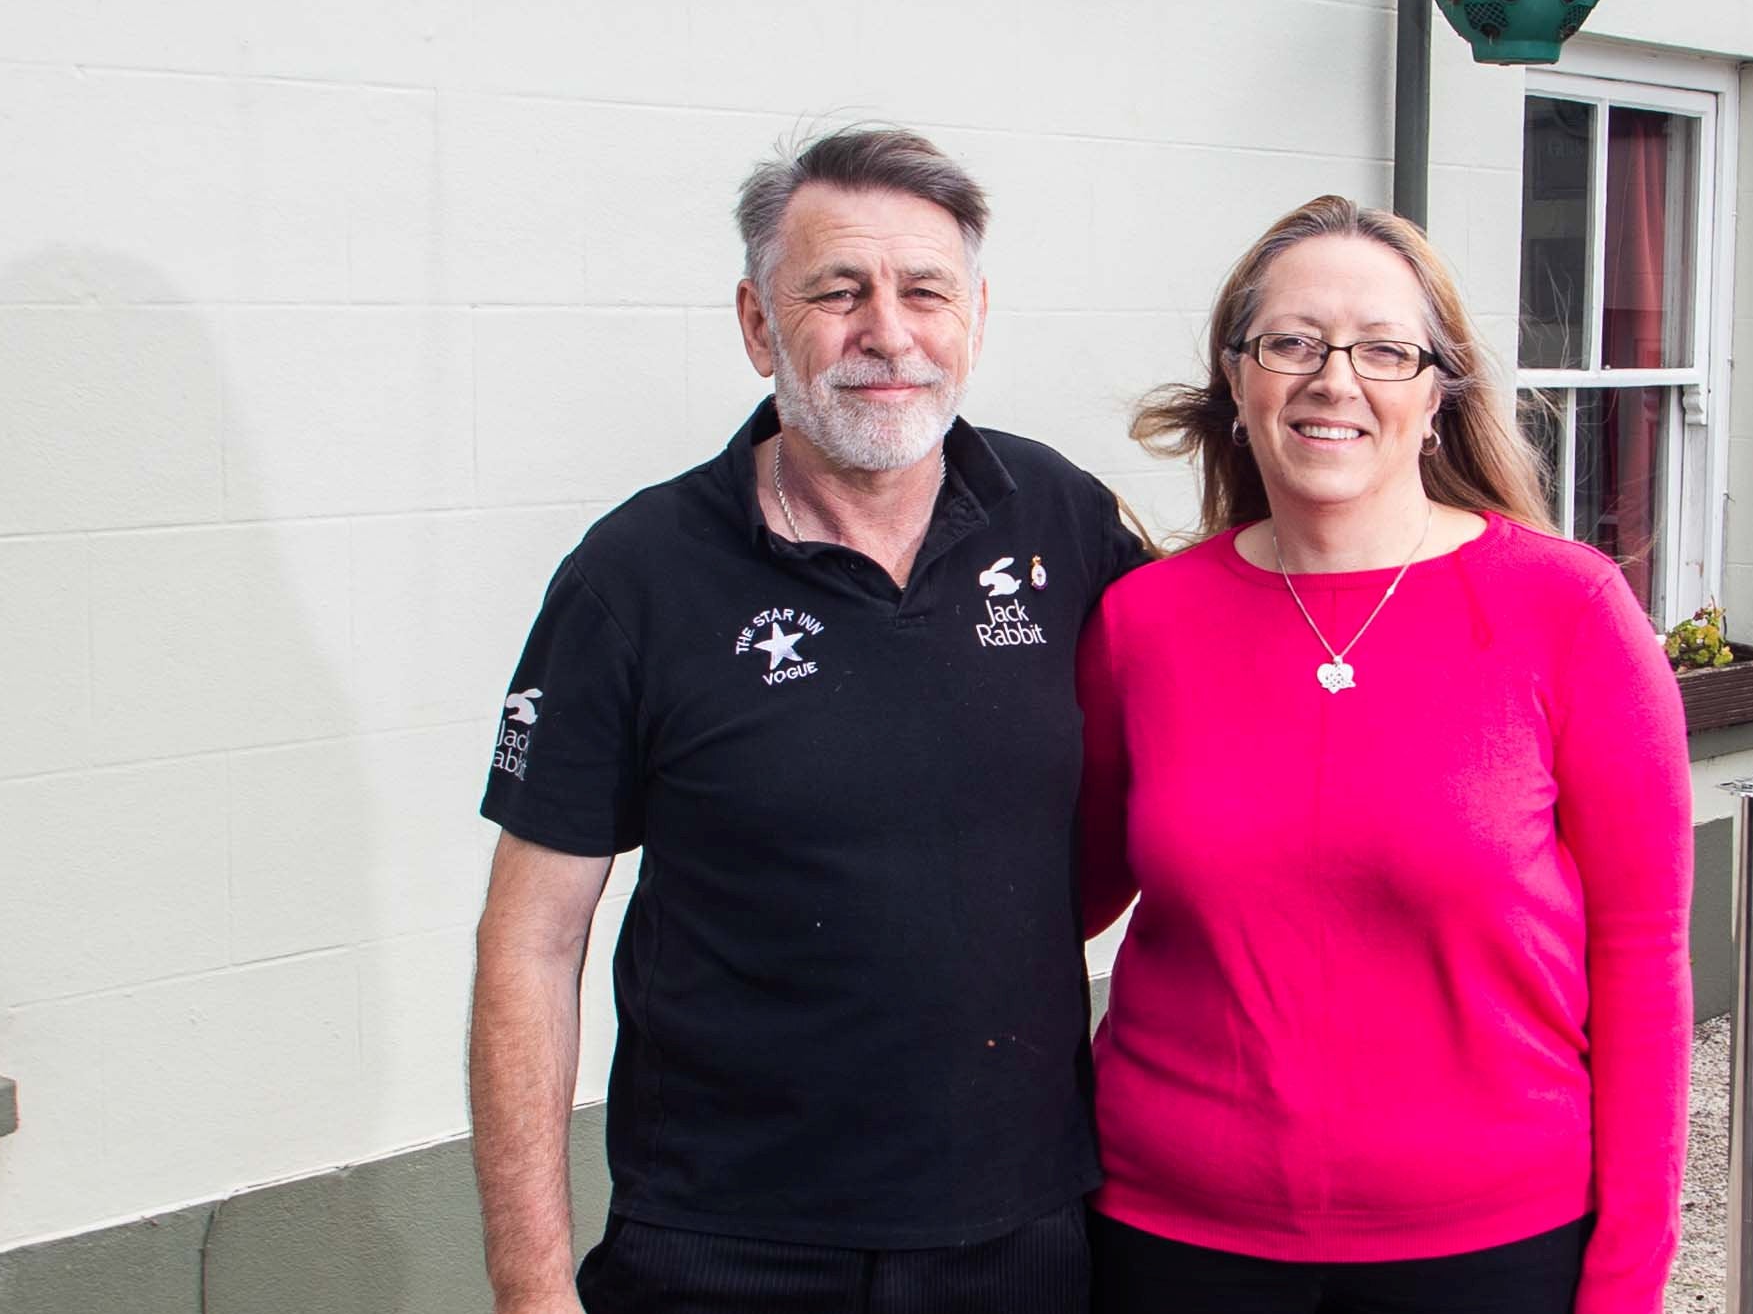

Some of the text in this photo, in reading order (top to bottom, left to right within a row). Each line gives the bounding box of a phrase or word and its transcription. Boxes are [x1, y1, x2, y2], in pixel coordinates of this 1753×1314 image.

[985, 599, 1029, 628] Jack
[735, 607, 824, 655] THE STAR INN
[976, 622, 1047, 647] Rabbit
[762, 661, 819, 686] VOGUE
